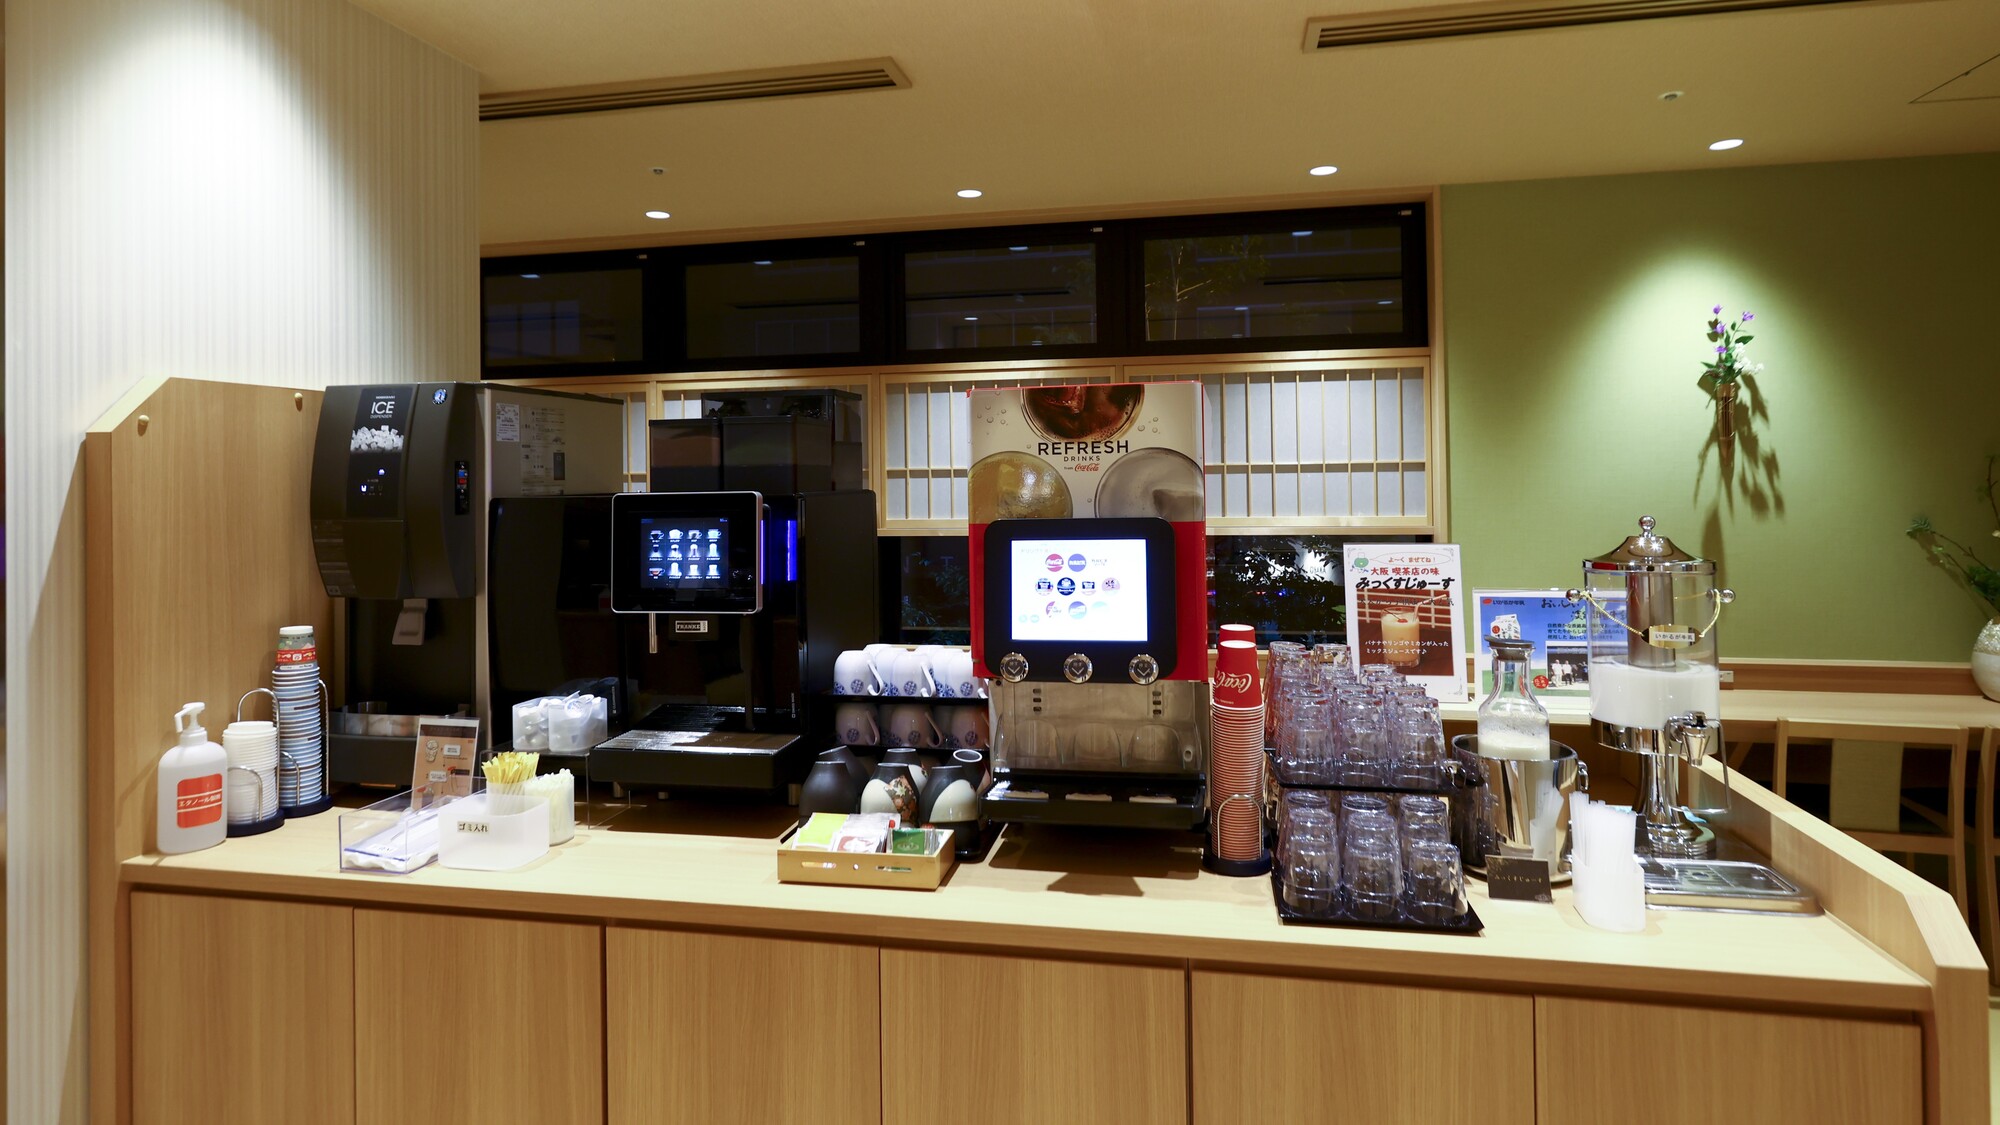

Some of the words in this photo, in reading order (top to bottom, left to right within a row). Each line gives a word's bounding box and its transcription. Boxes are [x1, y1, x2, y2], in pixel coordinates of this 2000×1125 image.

[371, 401, 395, 414] ICE
[1037, 440, 1129, 456] REFRESH
[1370, 567, 1389, 576] 大阪
[1392, 567, 1440, 576] 喫茶店の味
[1355, 577, 1455, 590] みっくすじゅーす
[459, 823, 488, 832] ゴミ入れ
